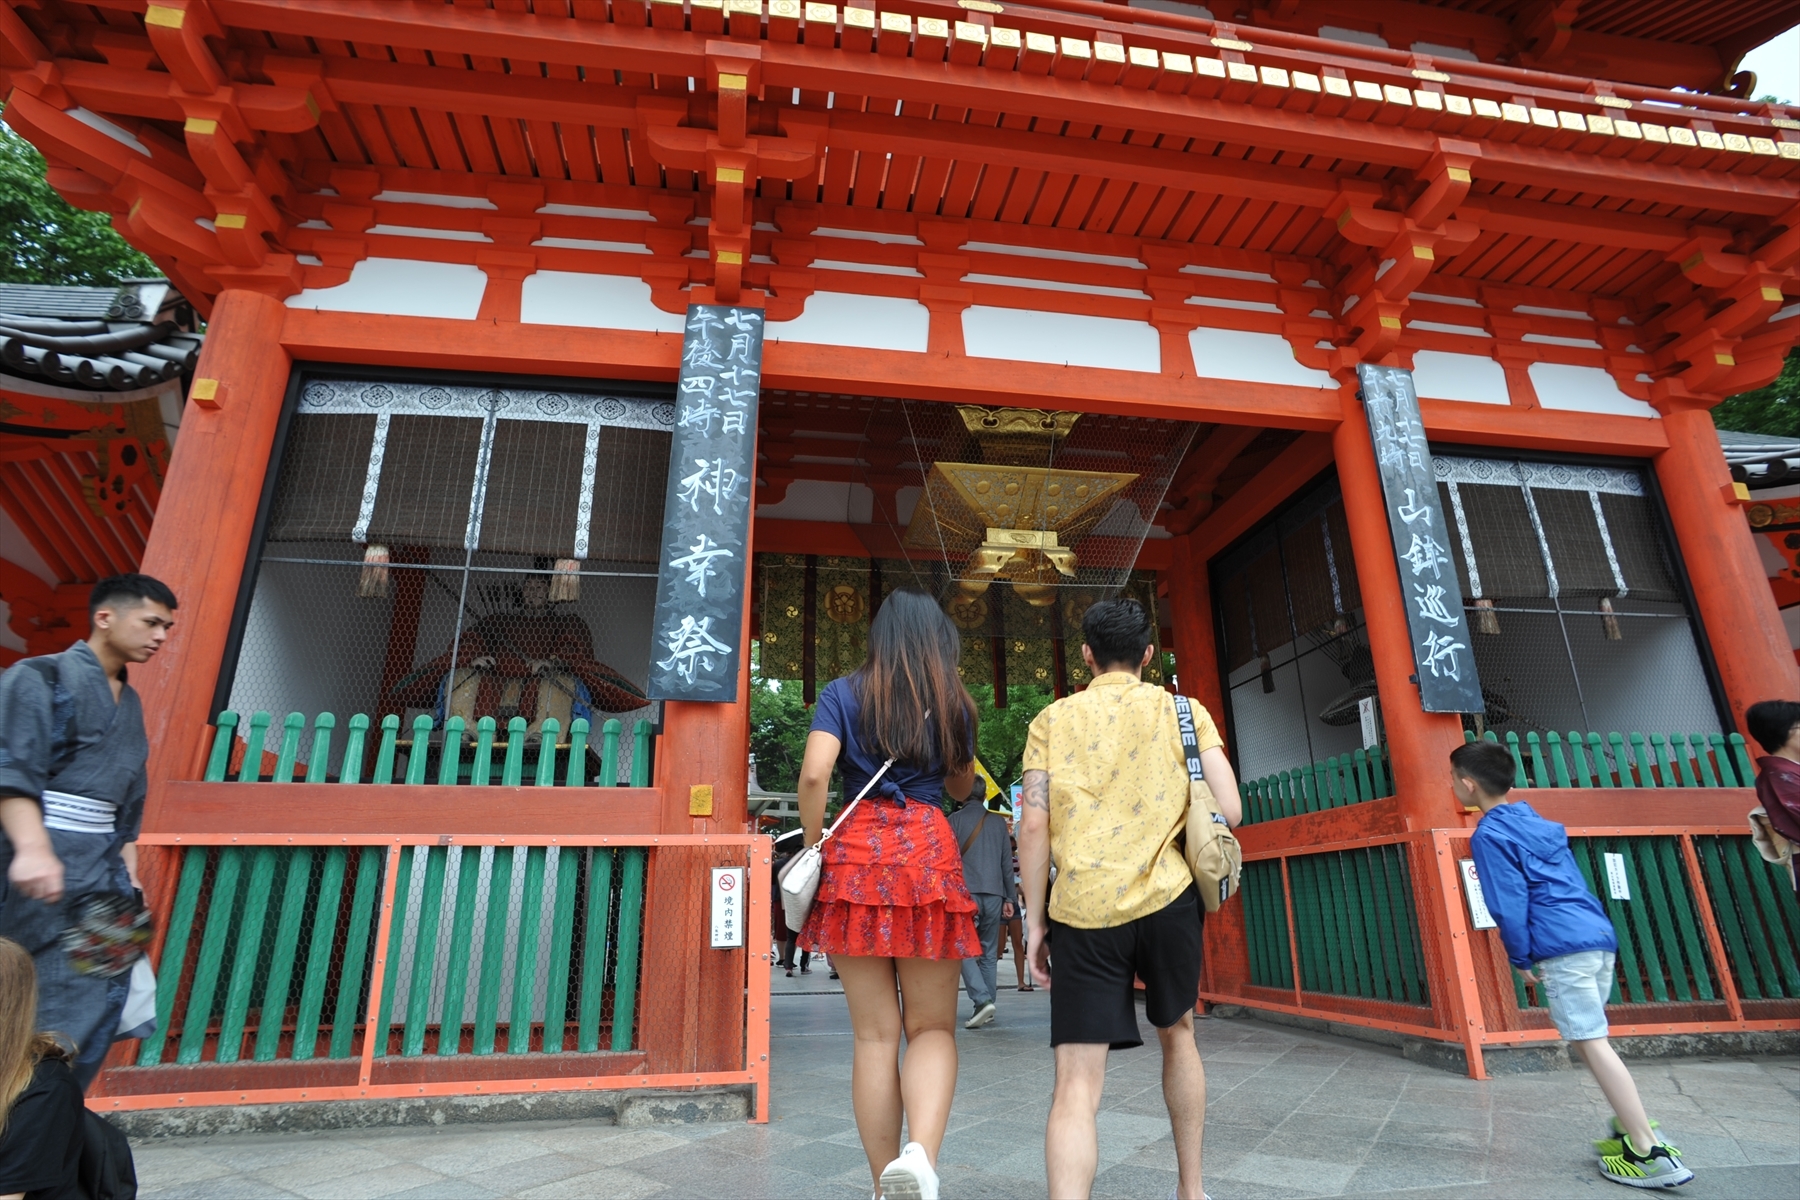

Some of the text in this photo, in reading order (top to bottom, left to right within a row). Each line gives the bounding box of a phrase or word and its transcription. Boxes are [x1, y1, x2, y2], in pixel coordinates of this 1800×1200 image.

[677, 306, 724, 438] 午後四時
[721, 308, 761, 435] 七月十七日
[1364, 365, 1406, 473] 午前九時
[1385, 370, 1426, 472] 七月十七日
[656, 458, 748, 684] 神幸祭
[1398, 488, 1466, 682] 山鉾巡行
[723, 895, 735, 941] 境内禁煙
